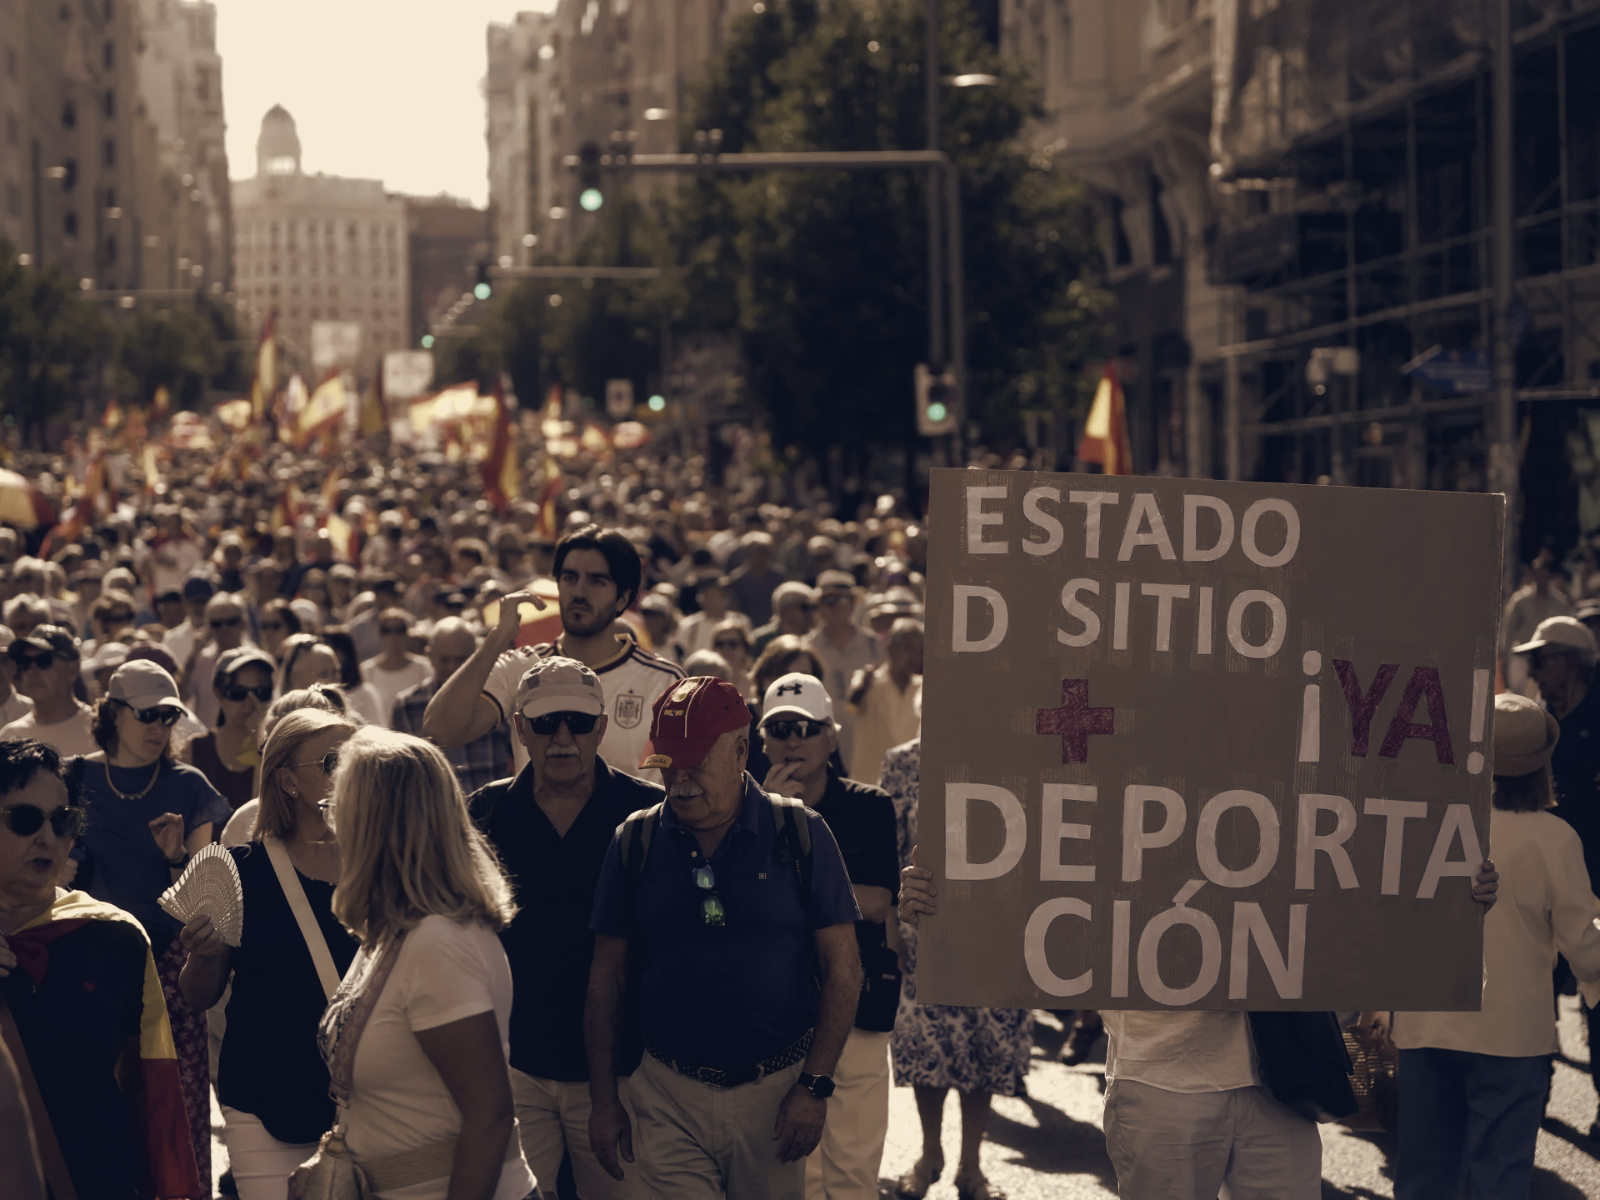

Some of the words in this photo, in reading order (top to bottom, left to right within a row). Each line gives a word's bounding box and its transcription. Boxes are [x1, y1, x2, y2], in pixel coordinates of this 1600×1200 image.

[966, 485, 1301, 567] ESTADO
[952, 584, 1008, 652] D
[1056, 577, 1288, 658] SITIO
[1298, 650, 1490, 775] ¡YA!
[944, 782, 1484, 899] DEPORTA
[1023, 879, 1308, 1006] CIÓN
